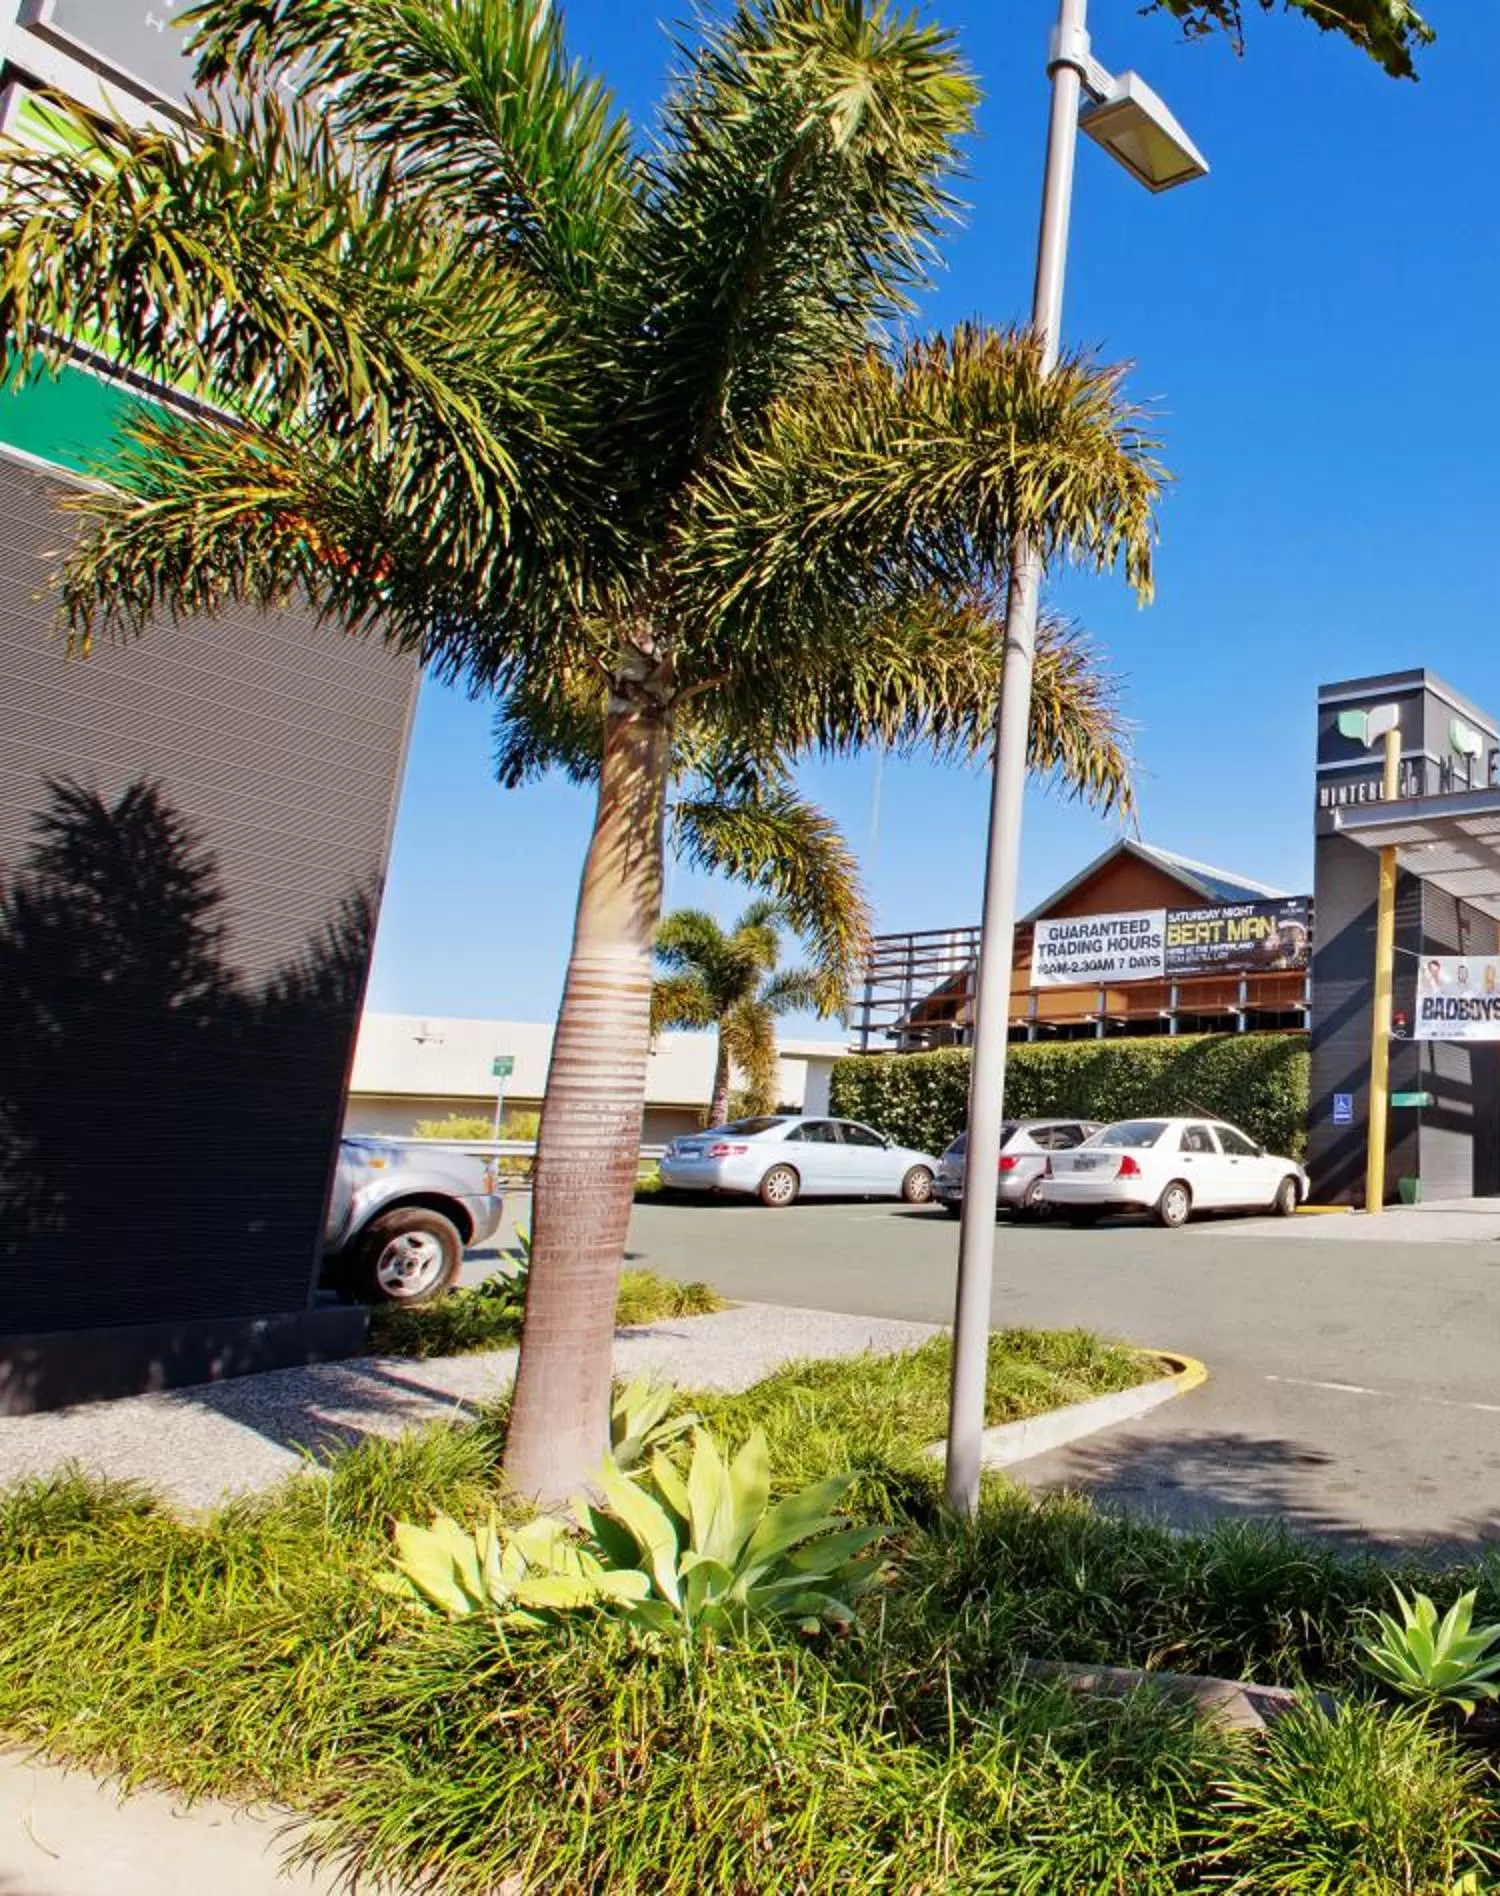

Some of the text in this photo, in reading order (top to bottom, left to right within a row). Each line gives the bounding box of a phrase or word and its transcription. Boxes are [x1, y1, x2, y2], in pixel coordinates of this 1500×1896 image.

[1168, 905, 1255, 922] SATURDAY NIGHT
[1049, 919, 1151, 941] GUARANTEED
[1167, 915, 1276, 946] BEAT MAN
[1038, 939, 1103, 957] TRADING
[1107, 933, 1161, 952] HOURS
[1118, 957, 1125, 969] 7
[1129, 955, 1161, 970] DAYS
